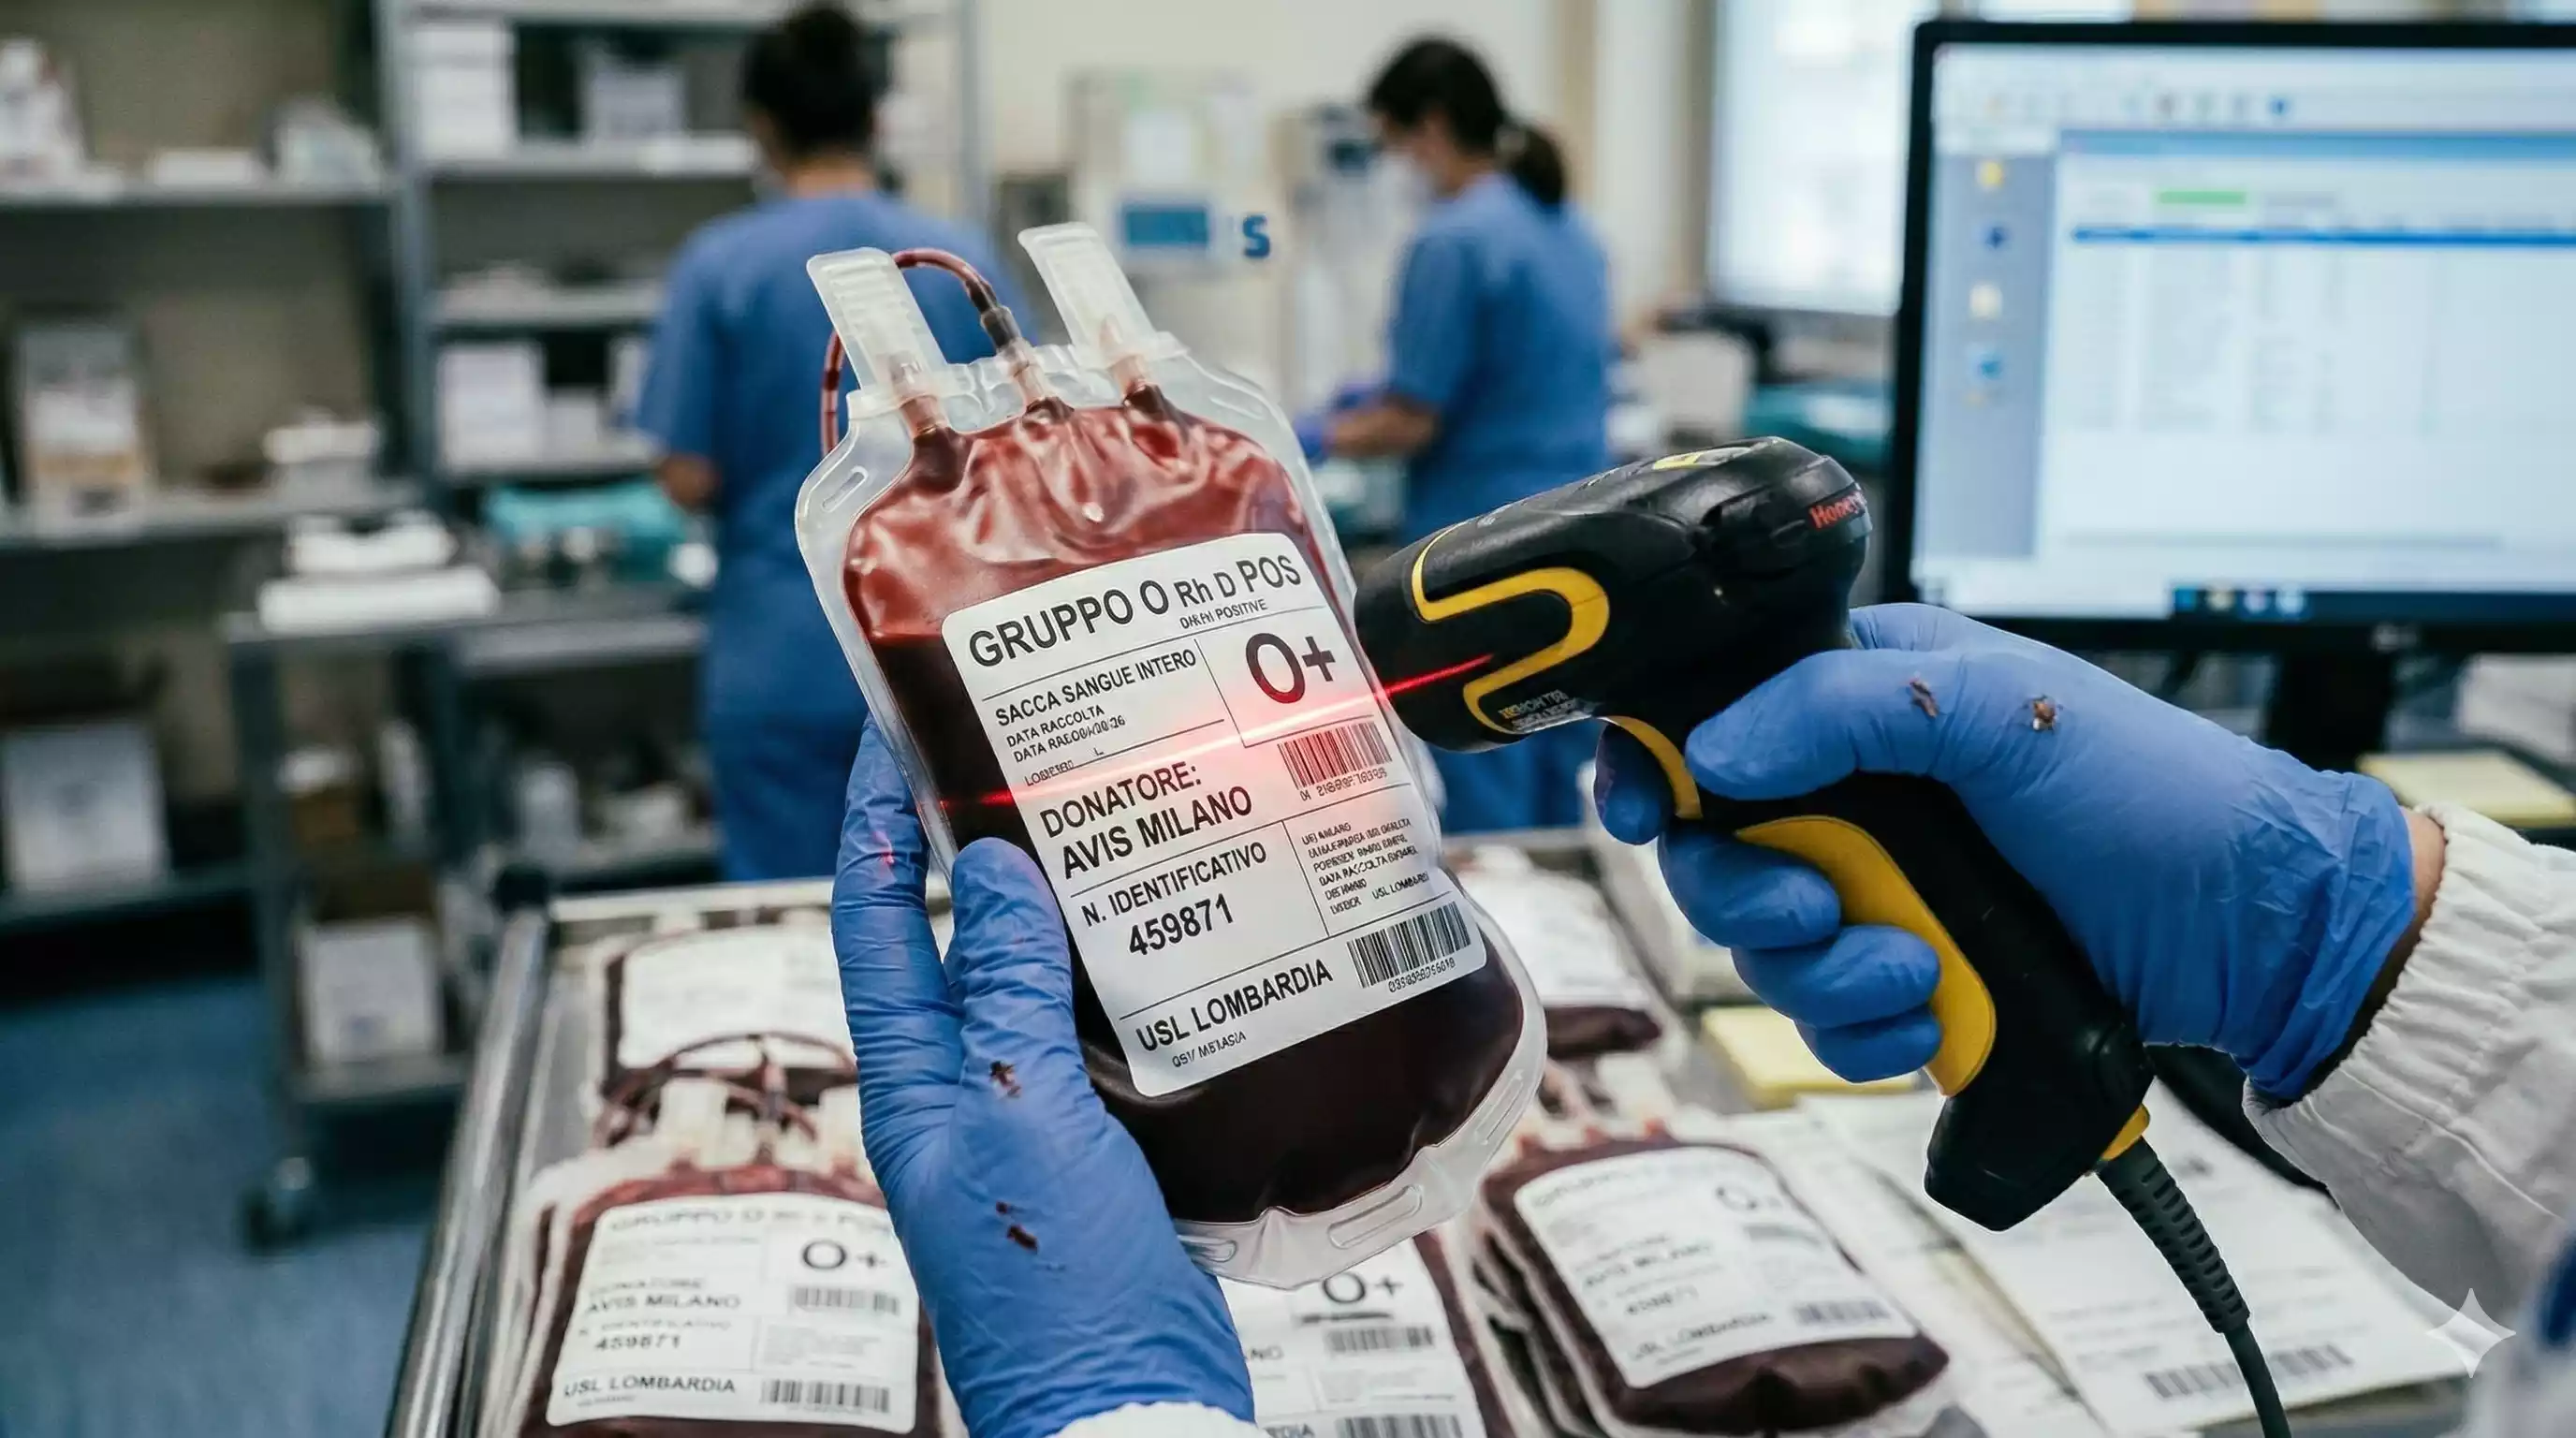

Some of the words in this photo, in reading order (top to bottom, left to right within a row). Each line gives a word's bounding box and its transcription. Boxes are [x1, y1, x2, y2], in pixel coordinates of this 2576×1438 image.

[969, 589, 1134, 667] GRUPPO
[1139, 579, 1169, 616] O
[1173, 579, 1214, 608] Rh
[1213, 572, 1237, 597] D
[1236, 555, 1301, 593] POS
[1215, 599, 1268, 620] POSITIVE
[996, 691, 1061, 726] SACCA
[1063, 667, 1135, 703] SANGUE
[1138, 649, 1197, 681] INTERO
[1244, 632, 1336, 704] O+
[1006, 728, 1040, 747] DATA
[1040, 705, 1105, 735] RACCOLTA
[1014, 743, 1047, 763] DATA
[1040, 760, 1203, 839] DONATORE:
[1061, 827, 1134, 879] AVIS
[1137, 785, 1253, 848] MILANO
[1081, 900, 1106, 927] N.
[1108, 842, 1267, 916] IDENTIFICATIVO
[1128, 891, 1235, 957] 459871
[1136, 1015, 1191, 1052] USL
[1191, 958, 1333, 1032] LOMBARDIA
[645, 1294, 741, 1308] MILANO
[564, 1377, 602, 1398] USL
[609, 1374, 737, 1393] LOMBARDIA
